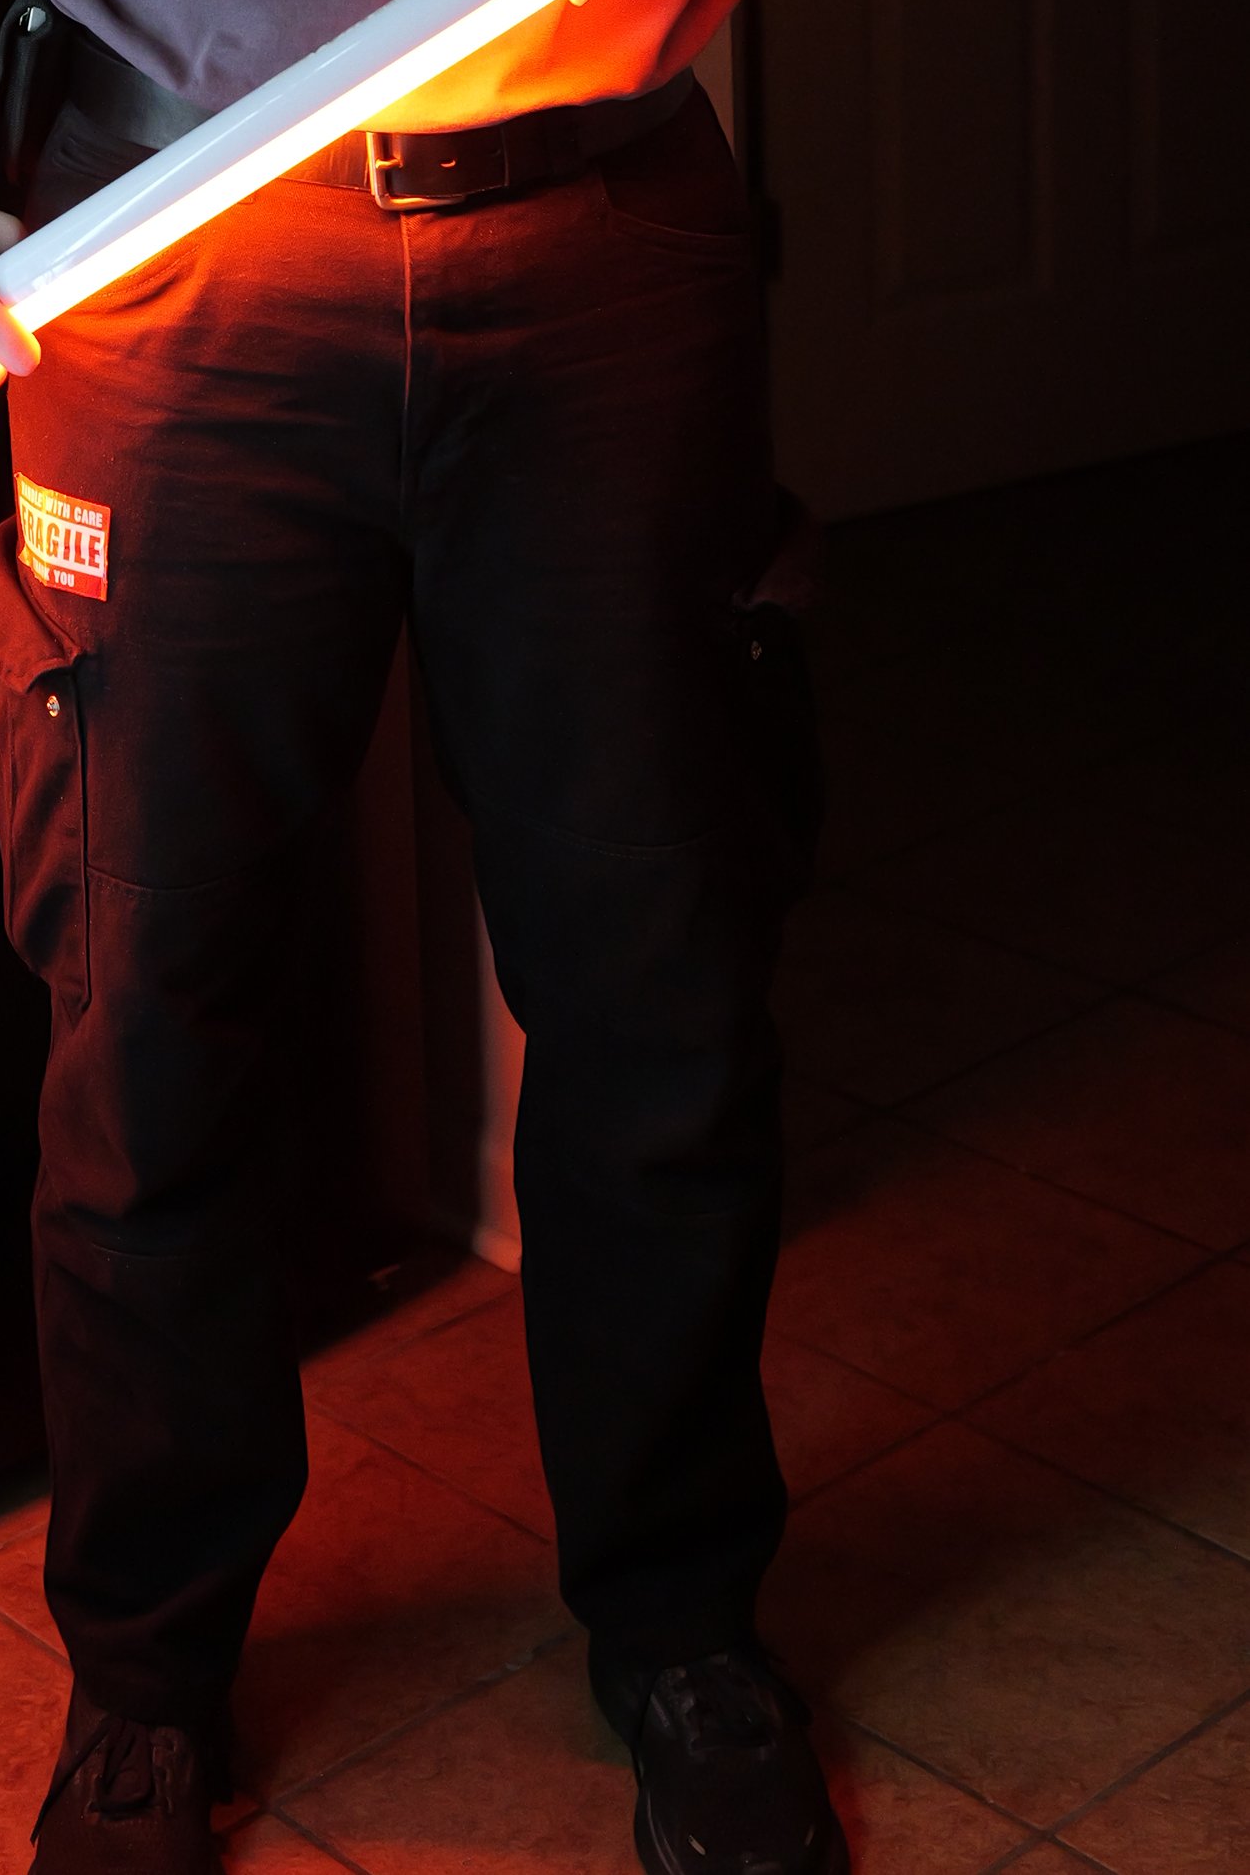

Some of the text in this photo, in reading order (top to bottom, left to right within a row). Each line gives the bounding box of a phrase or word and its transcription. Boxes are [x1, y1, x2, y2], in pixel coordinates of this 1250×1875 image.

[45, 496, 71, 519] WITH
[74, 507, 103, 528] CARE
[22, 505, 100, 567] FRAGILE
[53, 569, 75, 588] YOU
